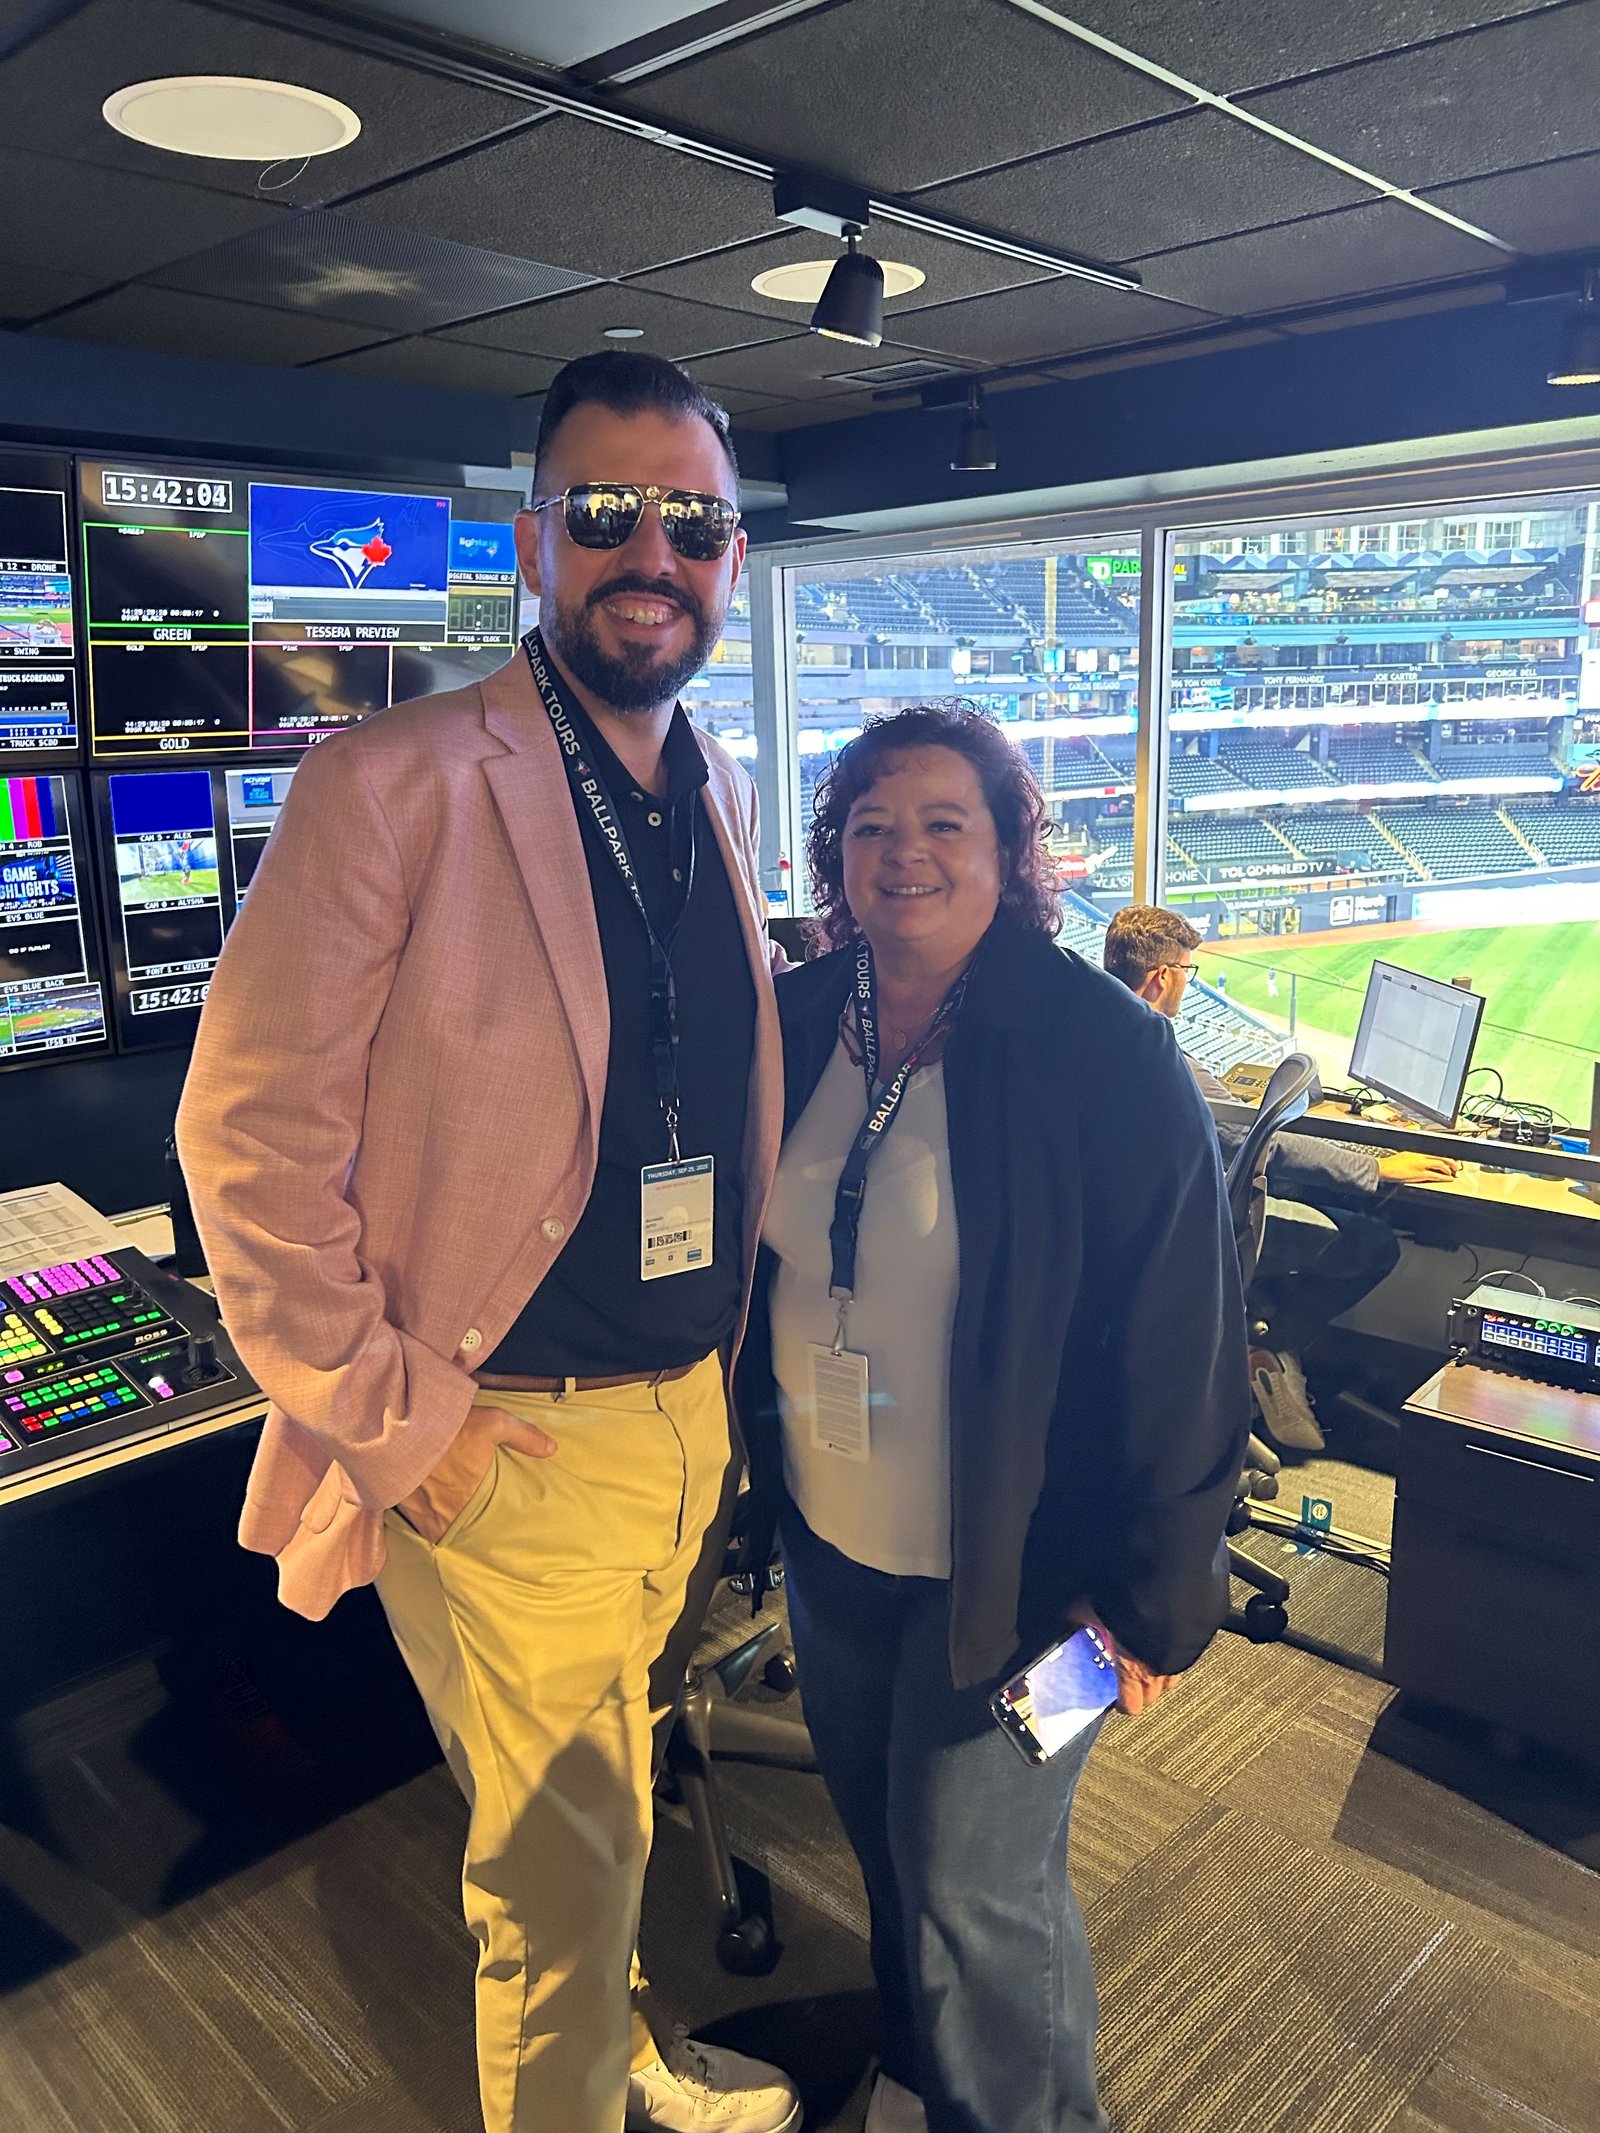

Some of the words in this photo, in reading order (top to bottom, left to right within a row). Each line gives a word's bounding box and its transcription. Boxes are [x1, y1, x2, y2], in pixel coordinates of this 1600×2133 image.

[106, 476, 227, 507] 15:42:04
[7, 562, 18, 571] 12
[31, 563, 57, 572] DRONE
[1090, 562, 1111, 580] TD
[153, 628, 192, 641] GREEN
[305, 626, 351, 639] TESSERA
[356, 627, 400, 639] PREVIEW
[13, 647, 40, 656] SWING
[1373, 673, 1388, 682] JOE
[1390, 672, 1418, 681] CARTER
[1485, 669, 1517, 678] GEORGE
[1520, 668, 1537, 676] BELL
[1184, 679, 1199, 687] TOM
[1264, 676, 1283, 685] TONY
[1285, 675, 1325, 684] FERNANDEZ
[1068, 682, 1091, 691] CARLOS
[1093, 681, 1120, 691] DELGADO
[546, 691, 581, 756] TOURS
[10, 739, 35, 748] TRUCK
[159, 738, 190, 750] GOLD
[308, 733, 337, 744] PIN
[581, 778, 633, 879] BALLPARK
[140, 834, 155, 842] CAM
[173, 832, 192, 840] ALEX
[27, 840, 43, 849] ROB
[2, 866, 37, 883] GAME
[1219, 867, 1246, 879] TCL
[1309, 861, 1325, 873] TV
[144, 901, 159, 910] CAM
[178, 897, 204, 907] ALYSHA
[25, 911, 45, 920] BLUE
[183, 961, 209, 972] KELVIN
[856, 951, 871, 999] TOURS
[4, 985, 19, 994] EVS
[23, 982, 42, 991] BLUE
[45, 979, 65, 988] BACK
[134, 1329, 168, 1344] ROSS
